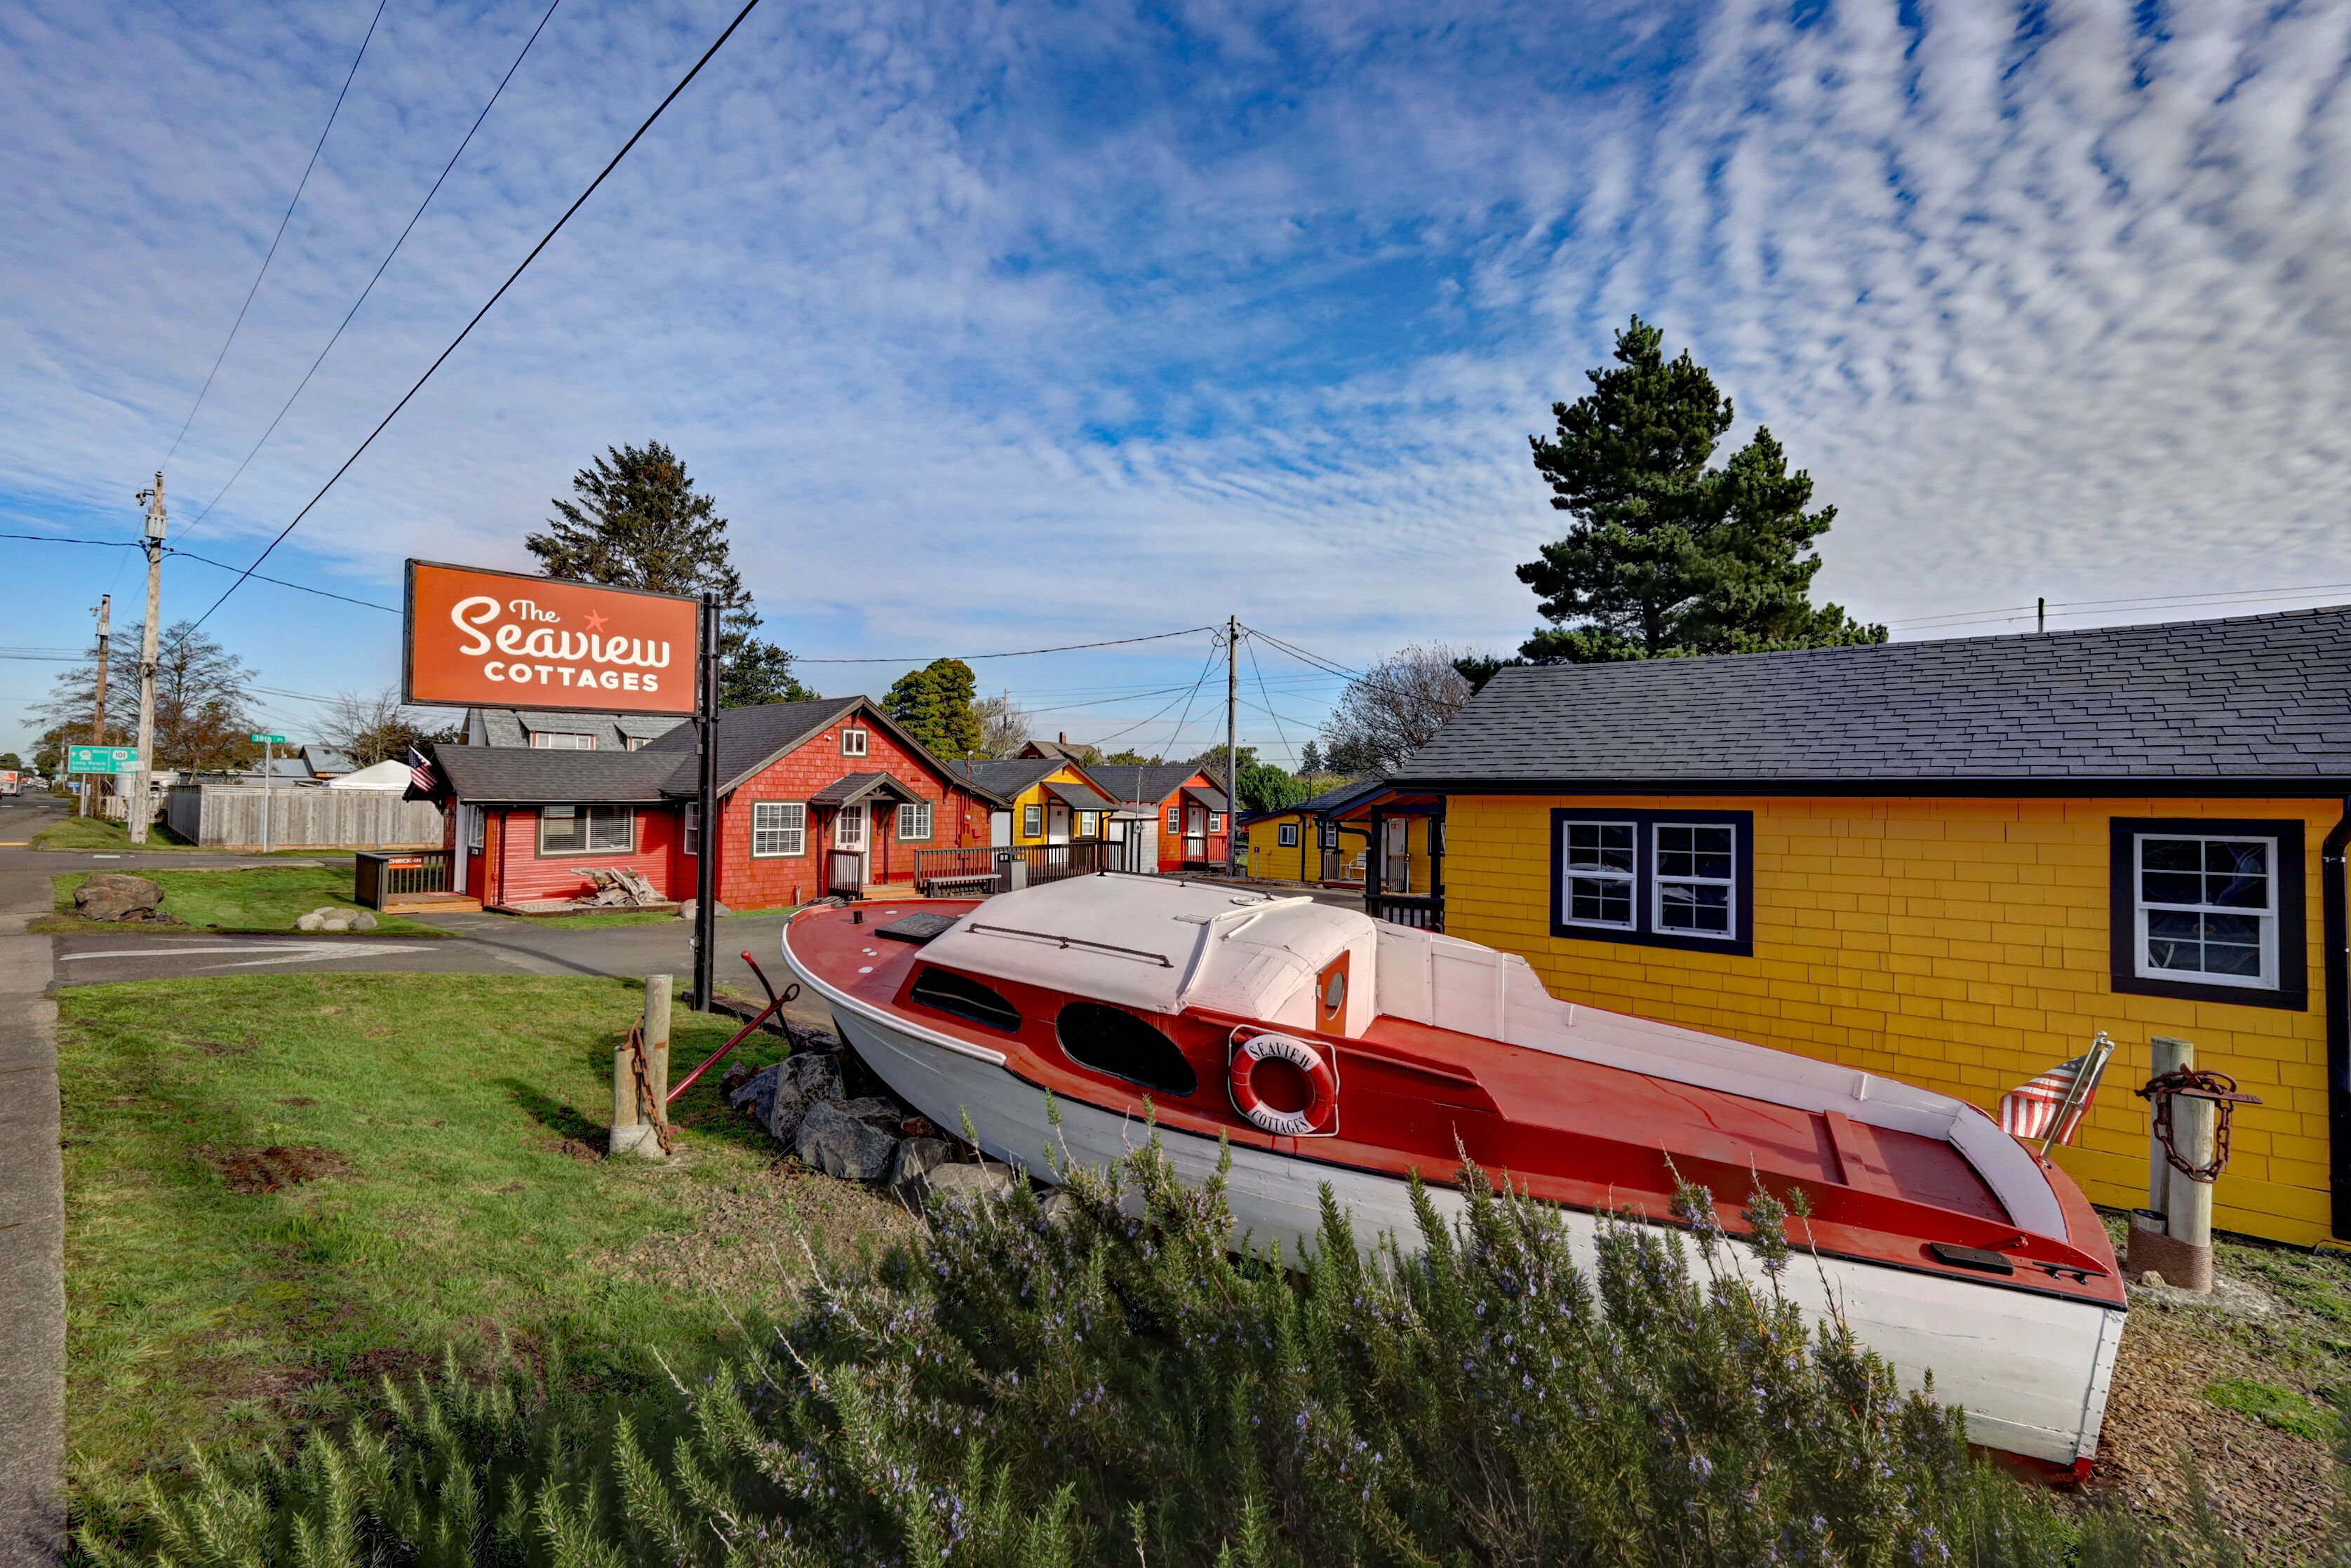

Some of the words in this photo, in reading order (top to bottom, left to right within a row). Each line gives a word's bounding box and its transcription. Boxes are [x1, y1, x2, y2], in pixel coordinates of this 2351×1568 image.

[509, 599, 561, 623] The
[451, 596, 670, 668] Seaview
[484, 662, 659, 692] COTTAGES
[1249, 1042, 1313, 1068] SEAVIEW
[1251, 1110, 1309, 1134] COTTAGES
